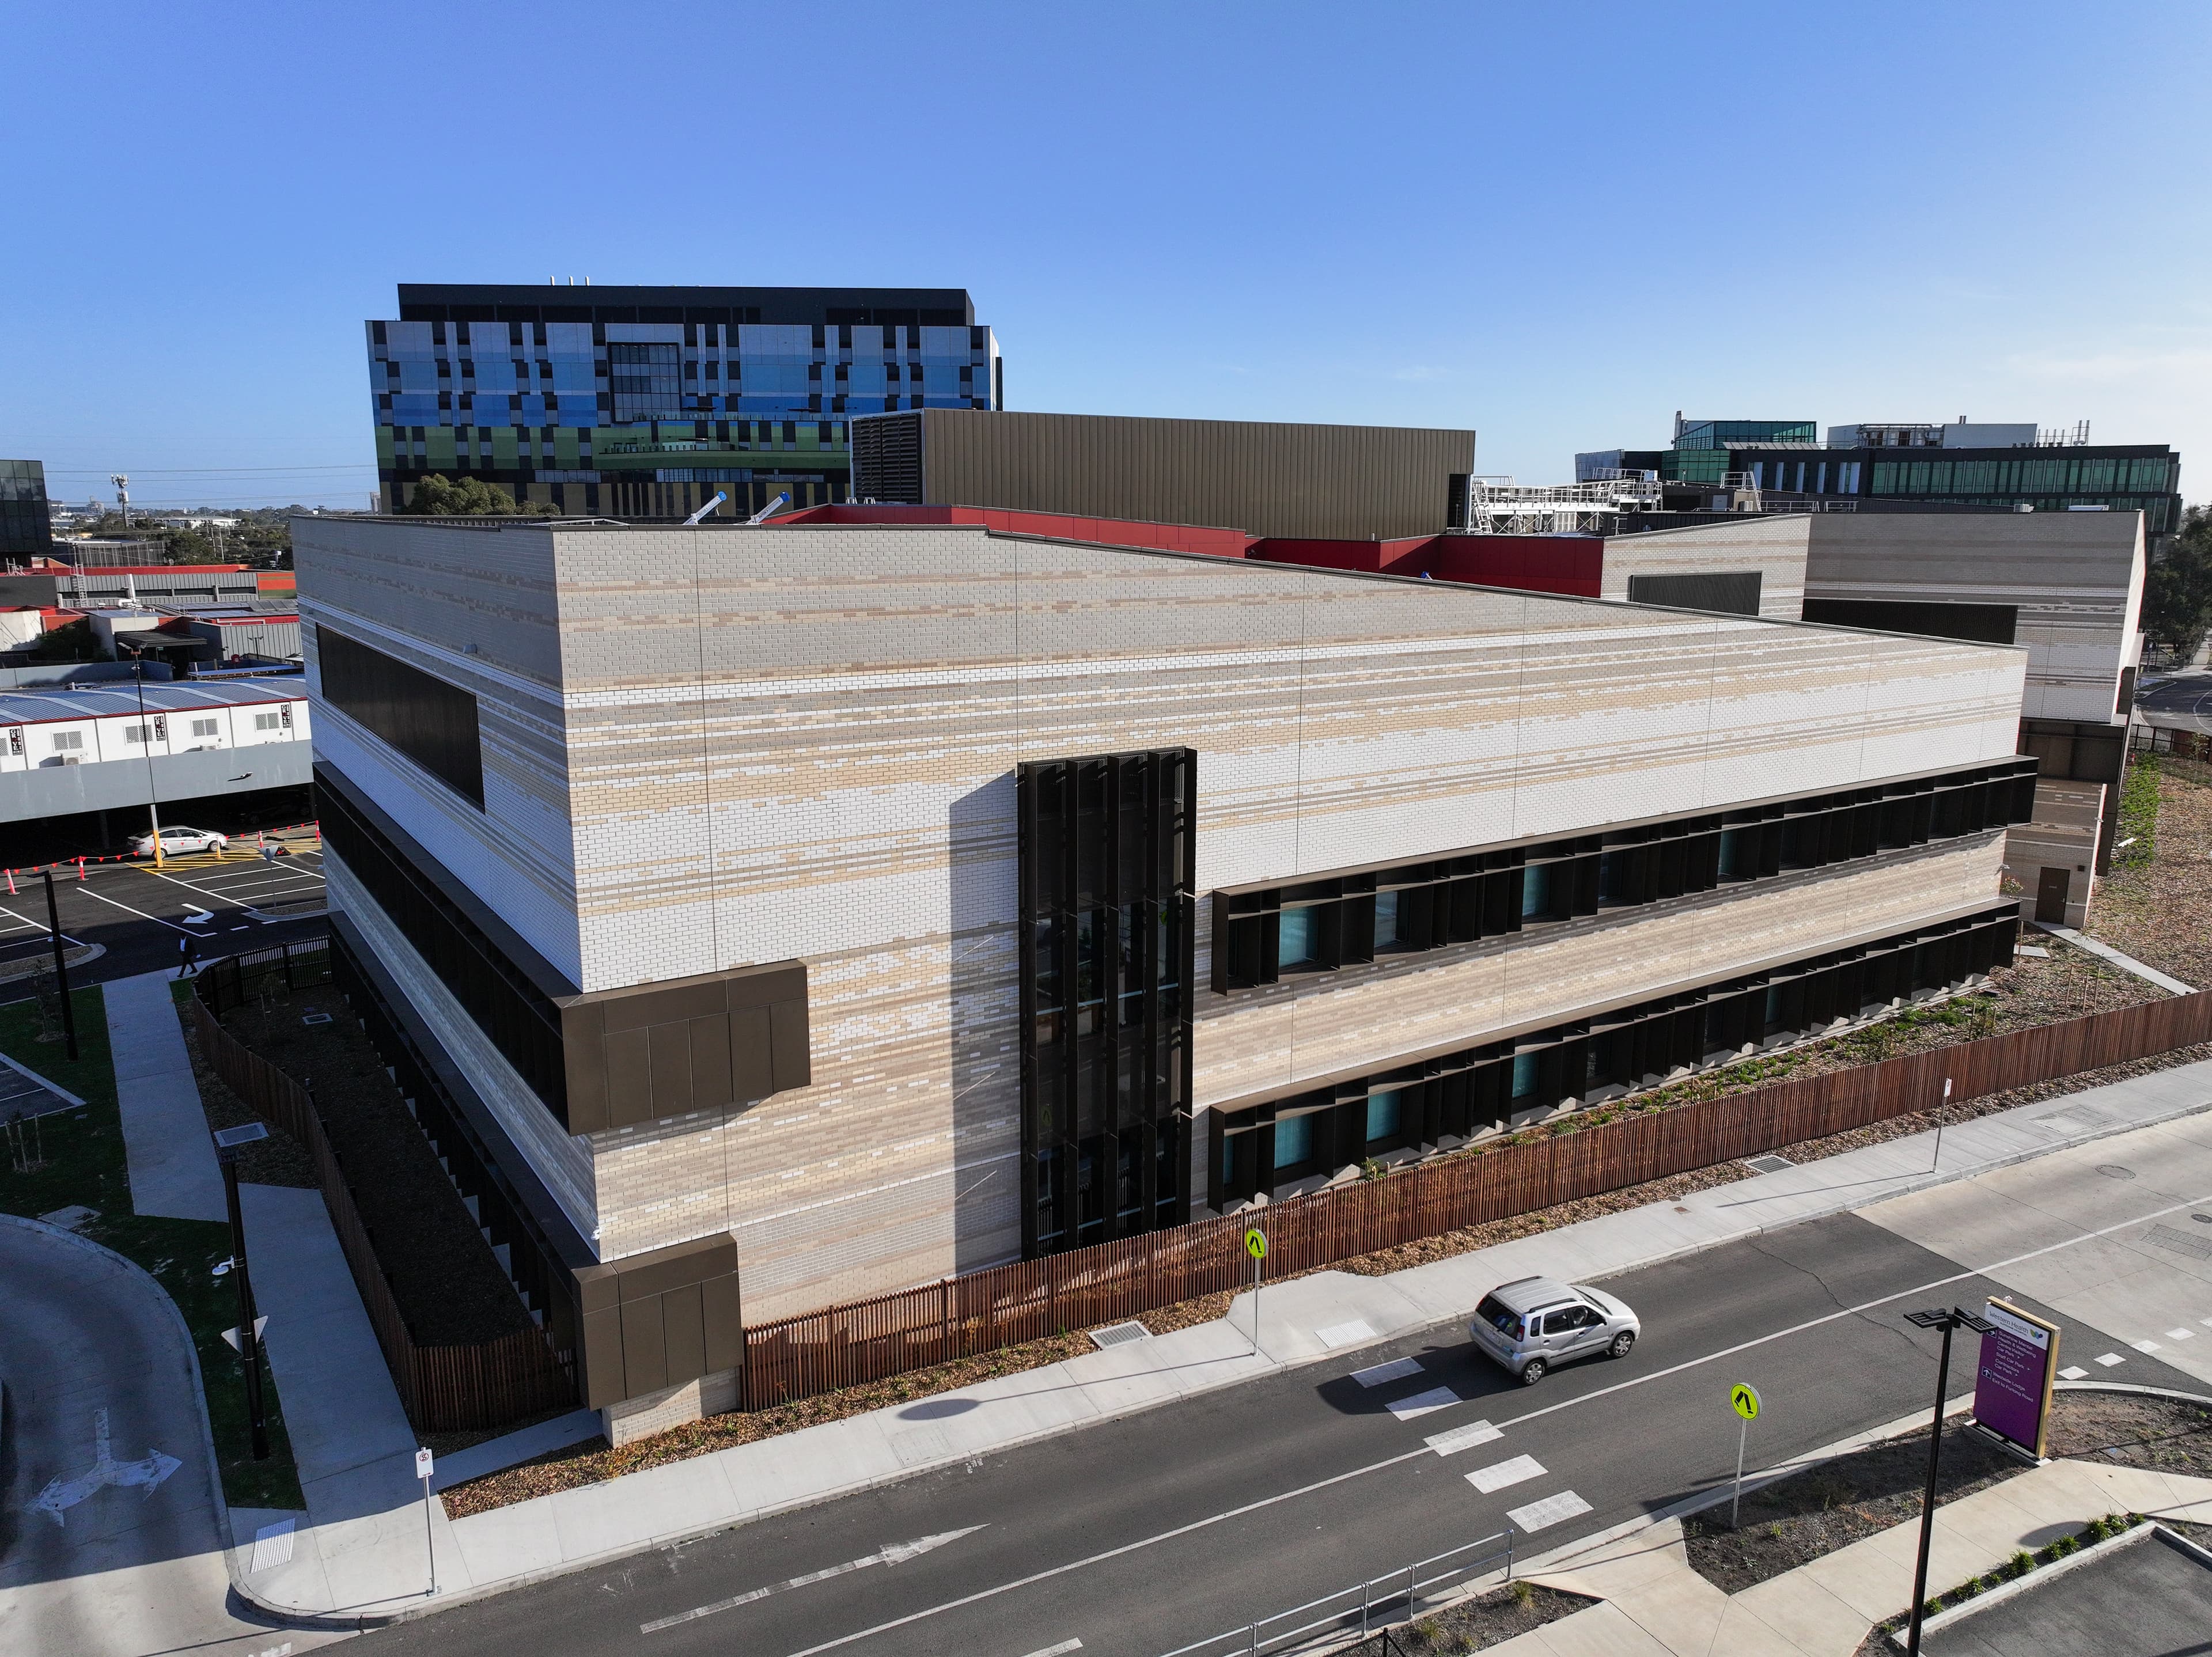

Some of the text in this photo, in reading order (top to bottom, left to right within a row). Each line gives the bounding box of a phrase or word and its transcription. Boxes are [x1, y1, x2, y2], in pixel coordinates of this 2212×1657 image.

[1989, 1311, 2028, 1334] Western Health
[1998, 1336, 2012, 1345] Health
[2016, 1344, 2036, 1358] Wellbeing
[2018, 1339, 2033, 1350] Mental
[1996, 1352, 2006, 1360] Staff
[2014, 1360, 2025, 1369] Park
[2005, 1349, 2014, 1358] Park
[1995, 1359, 2020, 1374] Contractors
[2002, 1367, 2013, 1375] Park
[1993, 1371, 2025, 1391] Westside Lodge
[2005, 1385, 2021, 1397] Furlong
[2021, 1393, 2034, 1402] Road
